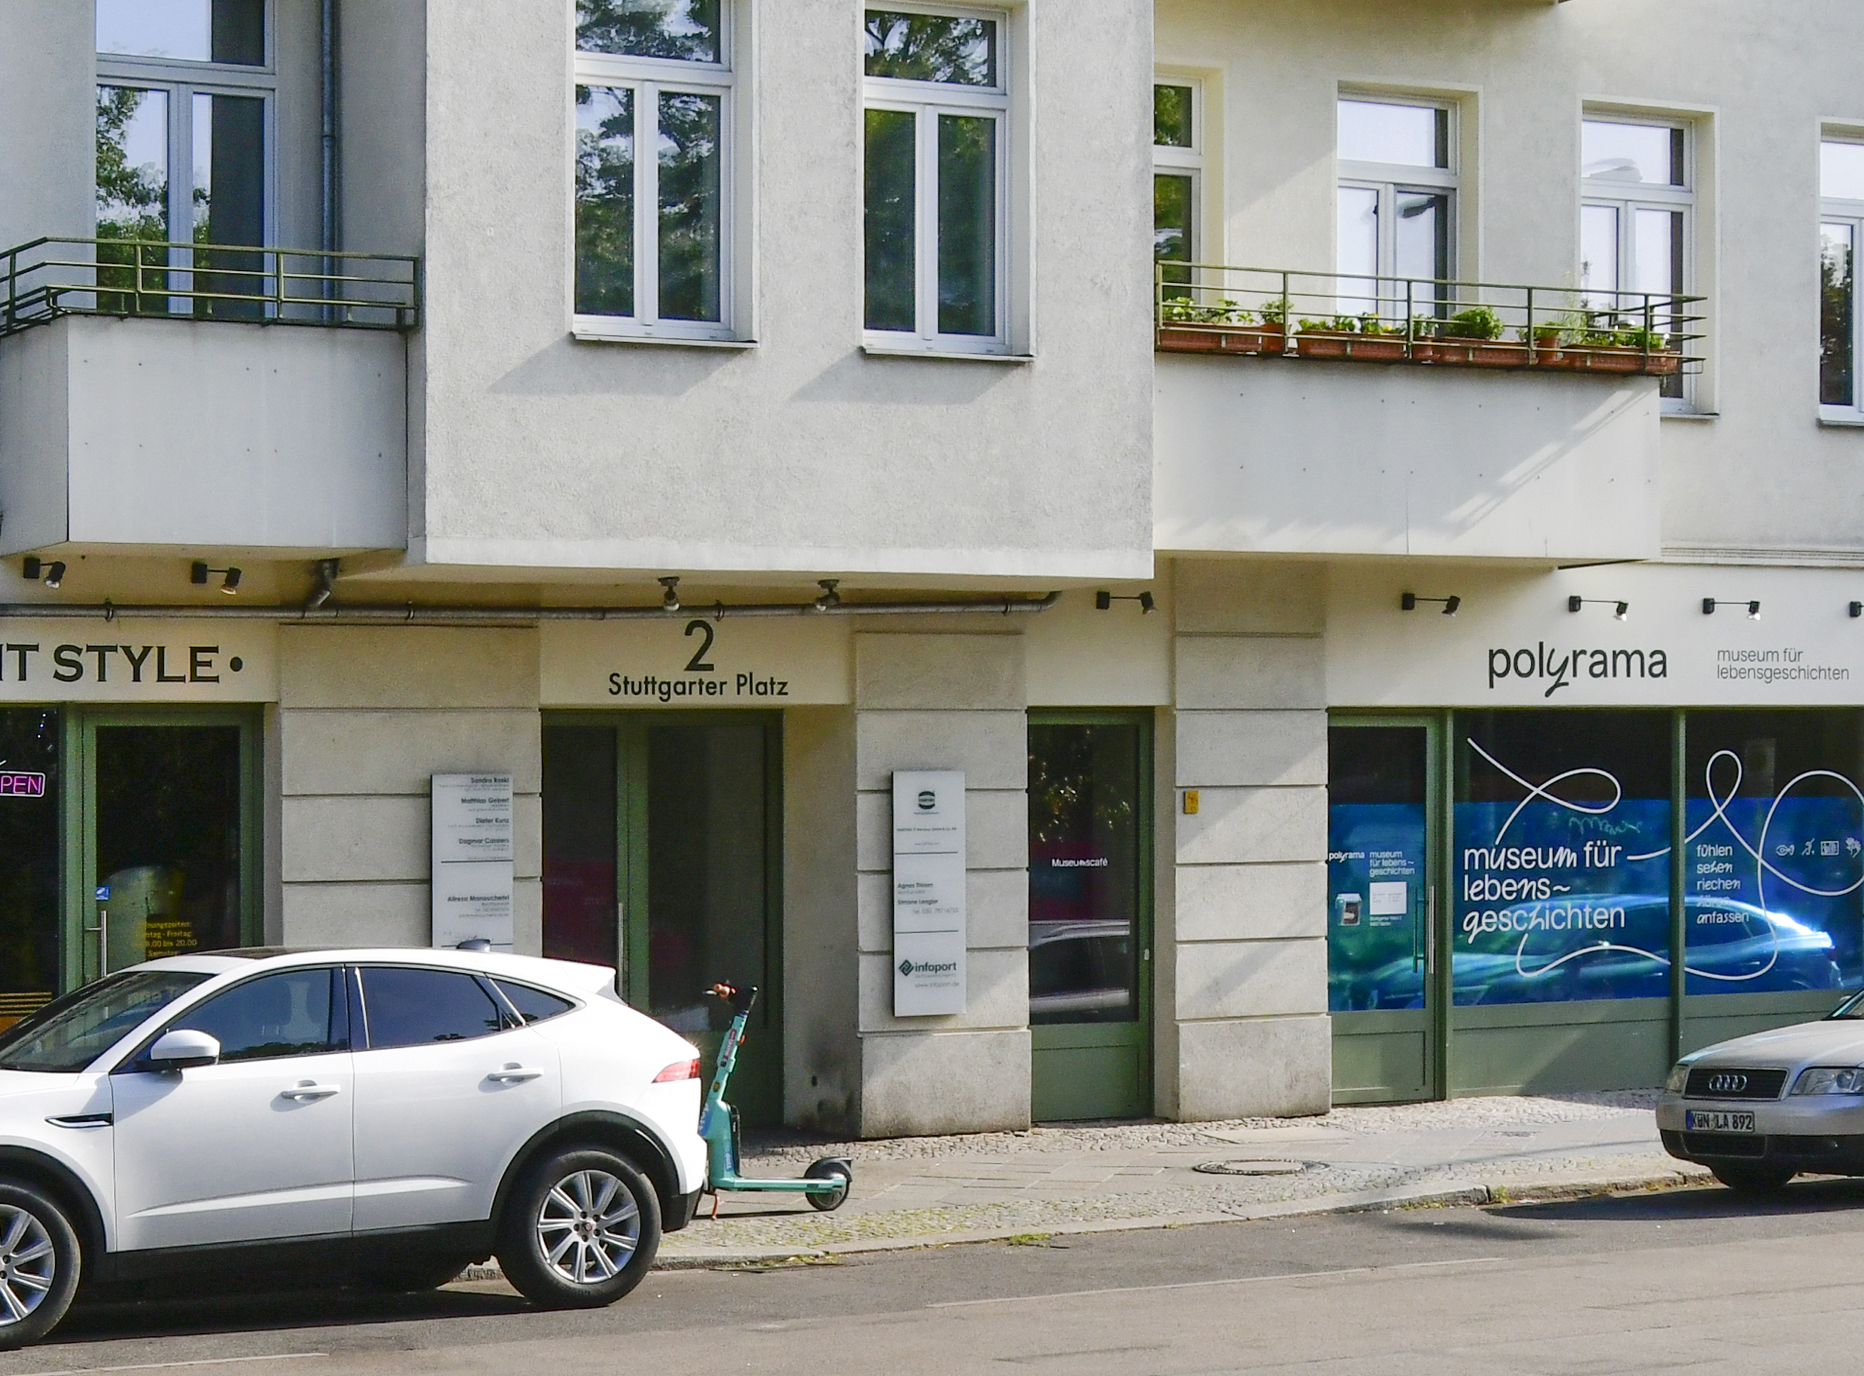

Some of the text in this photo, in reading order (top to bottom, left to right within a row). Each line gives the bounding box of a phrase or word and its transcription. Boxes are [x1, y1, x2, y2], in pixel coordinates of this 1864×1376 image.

[684, 619, 715, 671] 2
[52, 643, 220, 683] STYLE
[1717, 647, 1804, 663] museum für
[1488, 641, 1668, 698] polyrama
[1716, 664, 1850, 684] lebensgeschichten
[608, 672, 789, 702] Stuttgarter Platz
[1329, 851, 1402, 863] polyrama museum
[1463, 840, 1623, 871] museum für
[1696, 844, 1733, 858] fühlen
[1369, 859, 1381, 867] für
[1696, 861, 1733, 874] sehen
[1369, 867, 1415, 878] geschichten
[1696, 877, 1741, 891] riechen
[1462, 903, 1626, 945] geschichten
[1696, 911, 1750, 925] anfassen
[915, 962, 957, 974] infoport
[1732, 1114, 1752, 1130] 892
